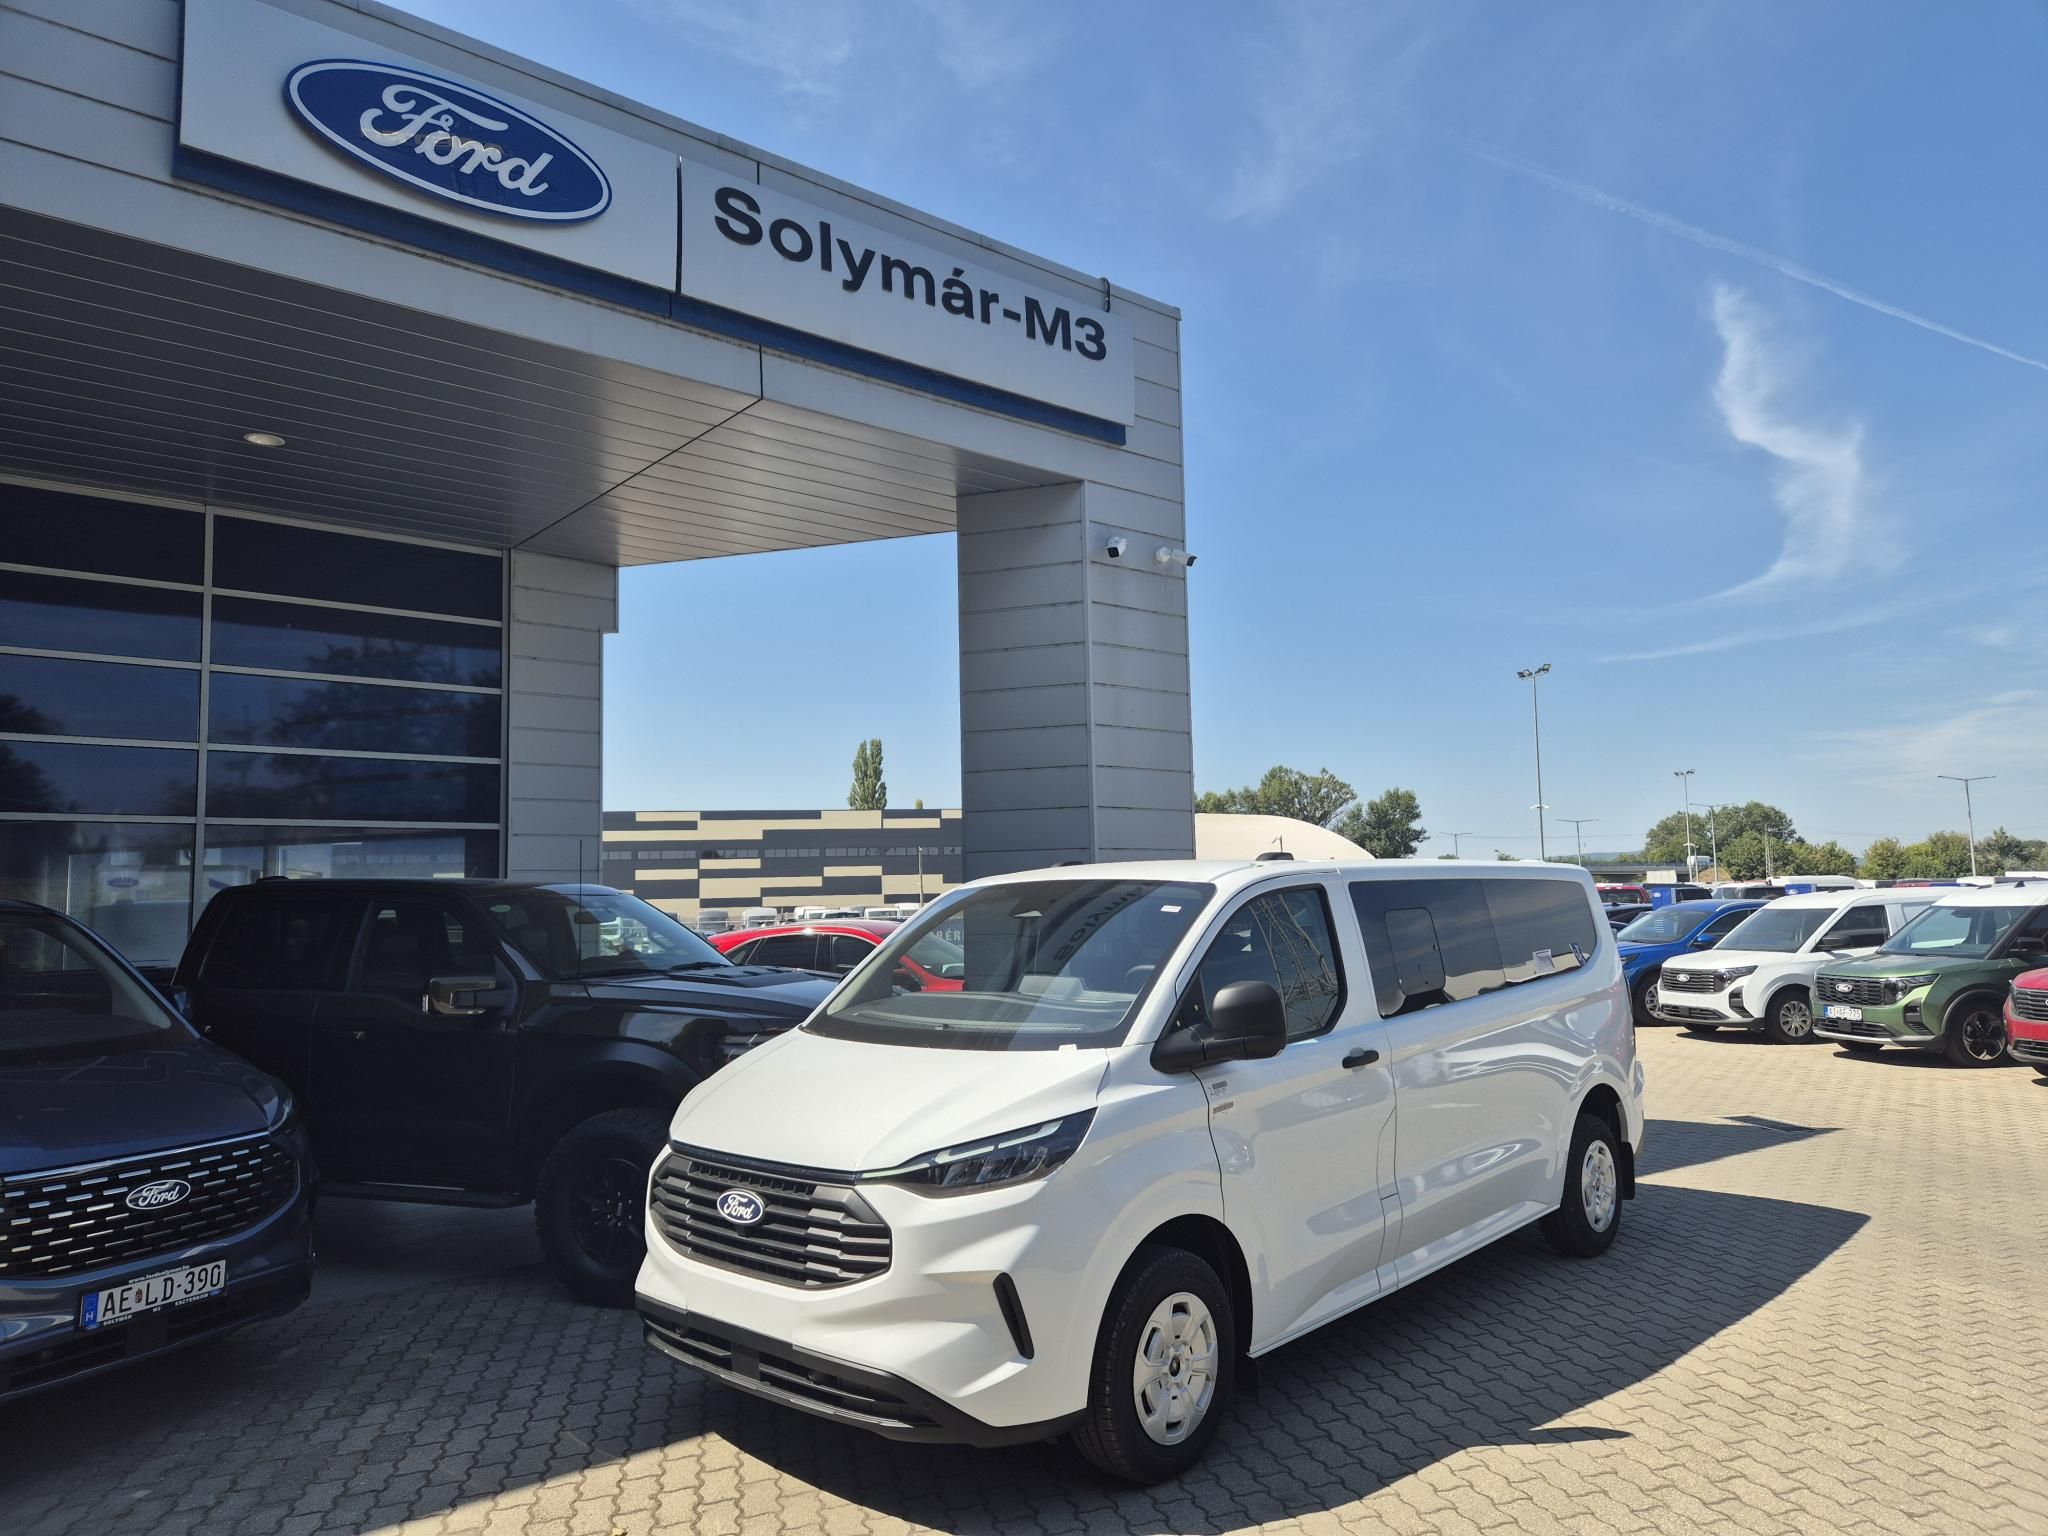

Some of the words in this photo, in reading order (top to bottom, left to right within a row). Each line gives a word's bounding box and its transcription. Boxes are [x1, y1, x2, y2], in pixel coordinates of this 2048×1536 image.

[359, 84, 550, 197] Ford
[714, 186, 1107, 361] Solymár-M3
[138, 1180, 179, 1207] Ford
[723, 1194, 755, 1219] Ford
[102, 1286, 133, 1319] AE
[145, 1264, 221, 1307] LD-390
[85, 1311, 94, 1322] H
